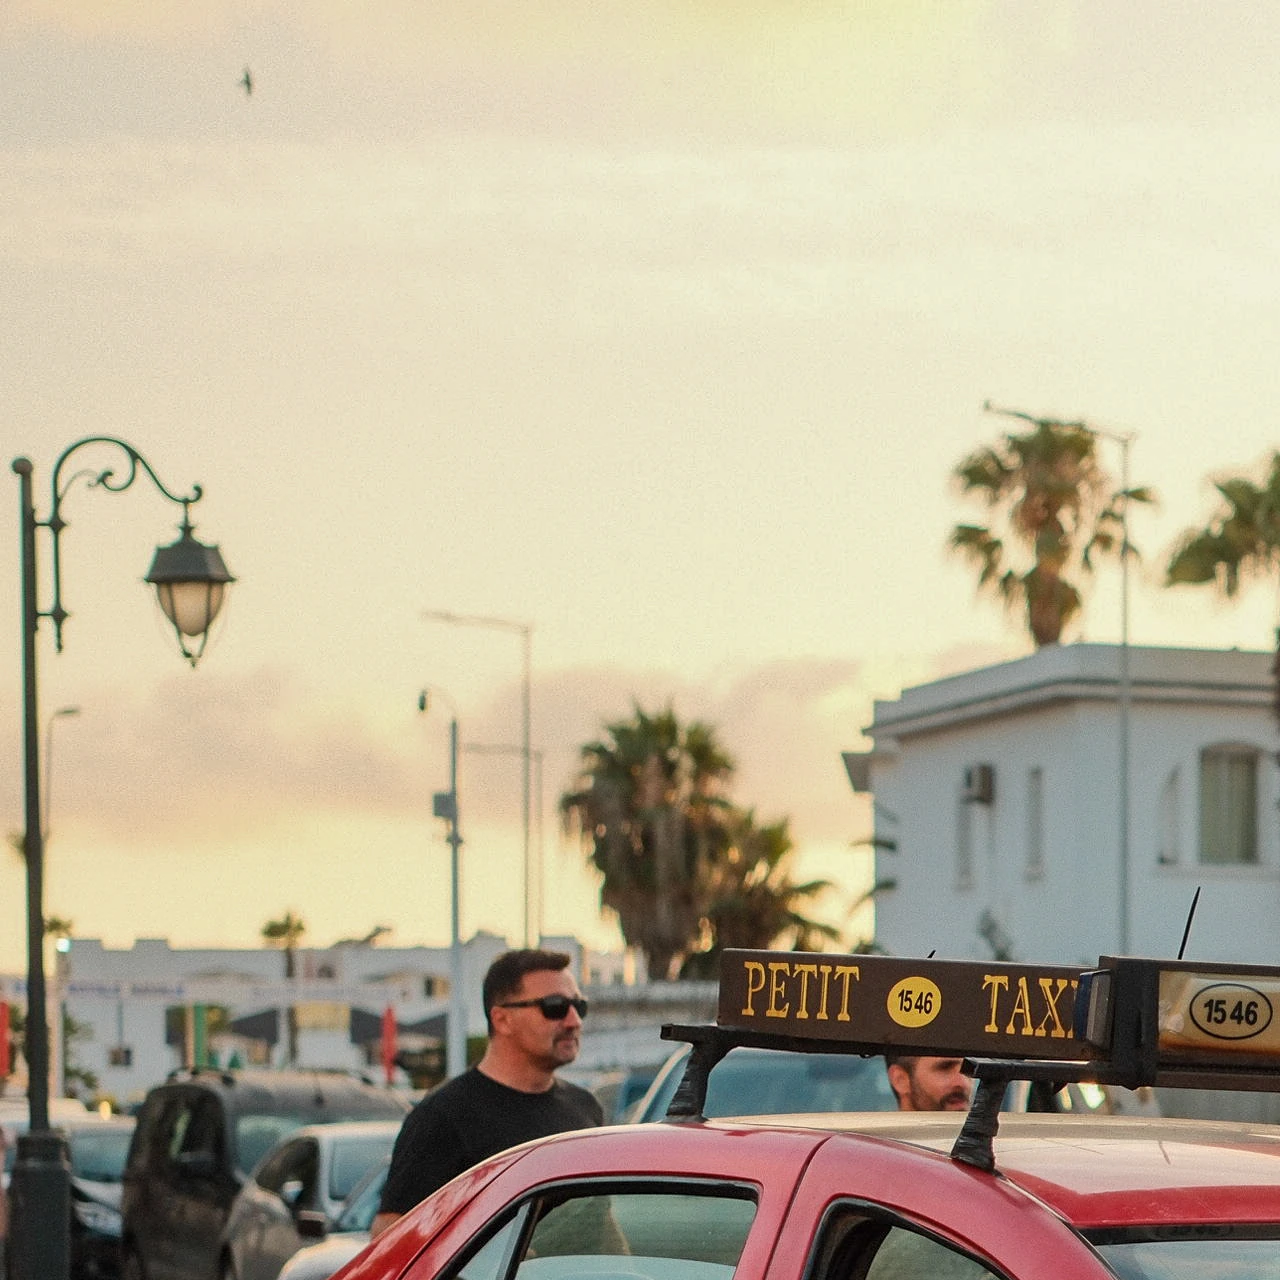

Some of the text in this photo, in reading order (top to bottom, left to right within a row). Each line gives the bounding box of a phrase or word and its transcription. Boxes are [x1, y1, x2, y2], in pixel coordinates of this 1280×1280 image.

[741, 960, 860, 1021] PETIT
[898, 988, 933, 1015] 1546
[1203, 998, 1259, 1026] 1546
